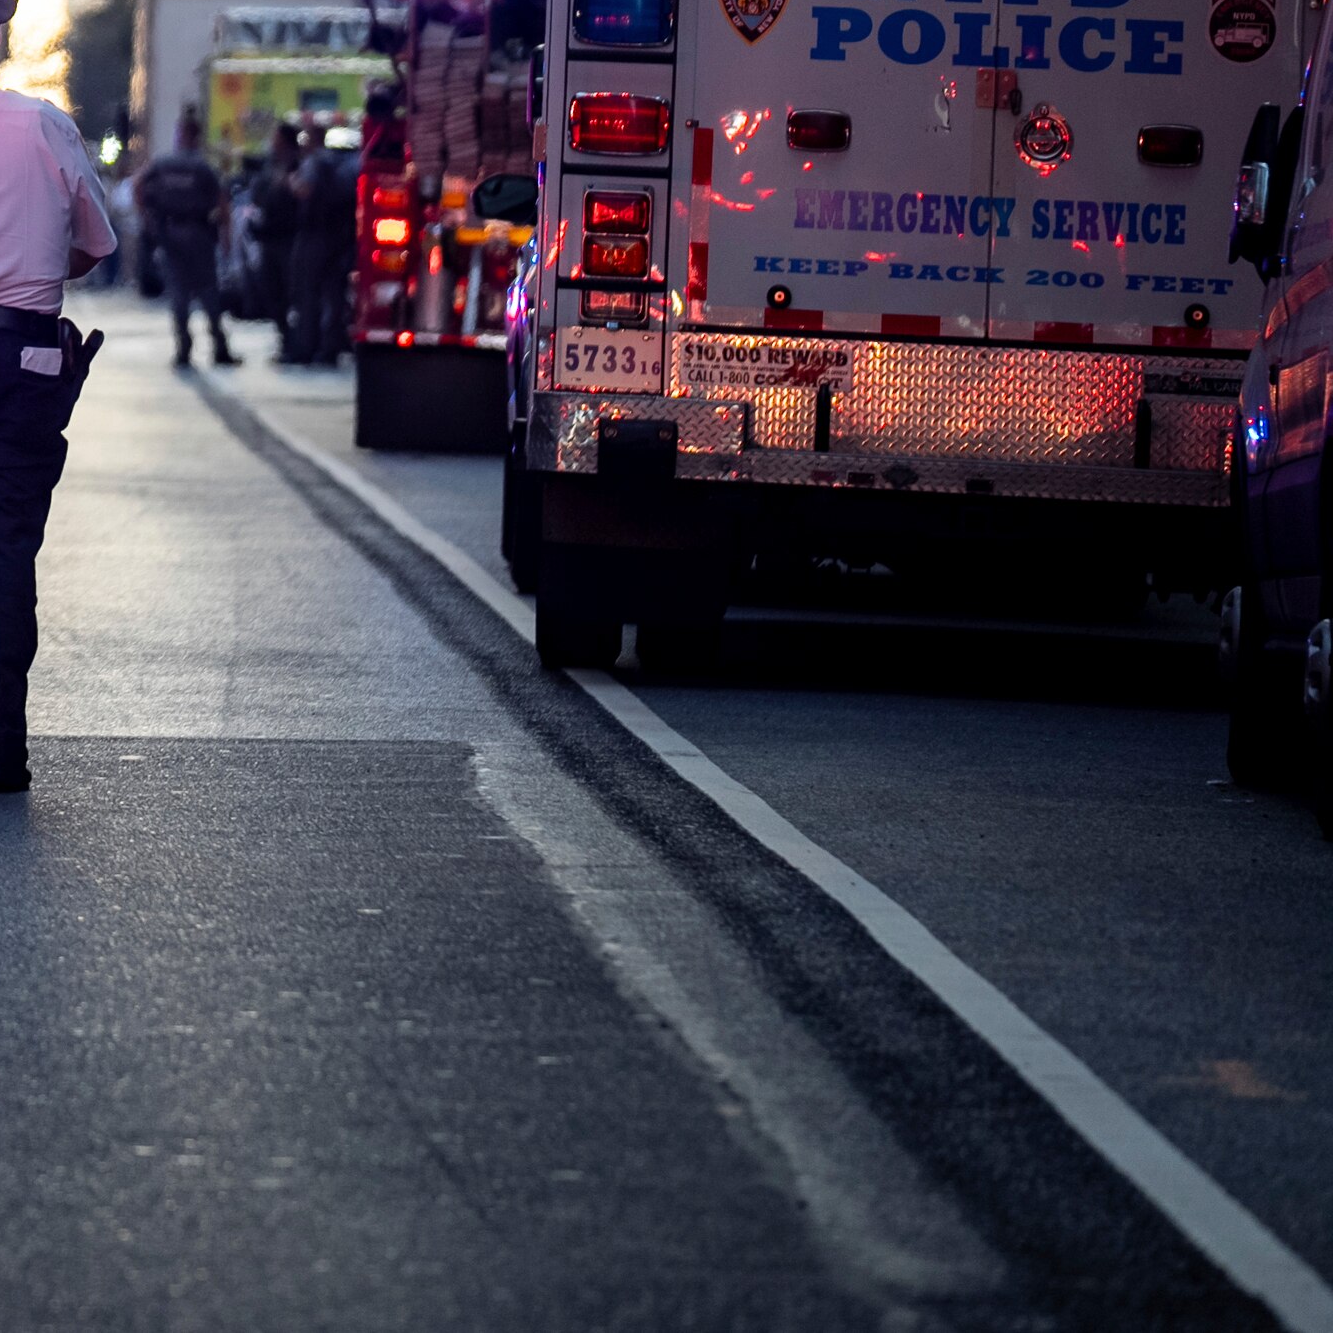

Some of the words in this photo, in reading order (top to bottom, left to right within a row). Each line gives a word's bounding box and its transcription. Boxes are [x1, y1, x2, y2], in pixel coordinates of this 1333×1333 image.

[1233, 11, 1256, 20] NYPD
[810, 6, 1184, 75] POLICE
[793, 188, 1016, 237] EMERGENCY
[1032, 199, 1187, 245] SERVICE
[753, 255, 869, 277] KEEP
[889, 263, 1005, 284] BACK
[1026, 269, 1105, 289] 200
[1125, 274, 1234, 296] FEET
[564, 343, 637, 374] 5733
[640, 360, 661, 376] 16
[768, 347, 848, 366] REWARD
[687, 369, 715, 383] CALL
[719, 371, 750, 384] 1-800
